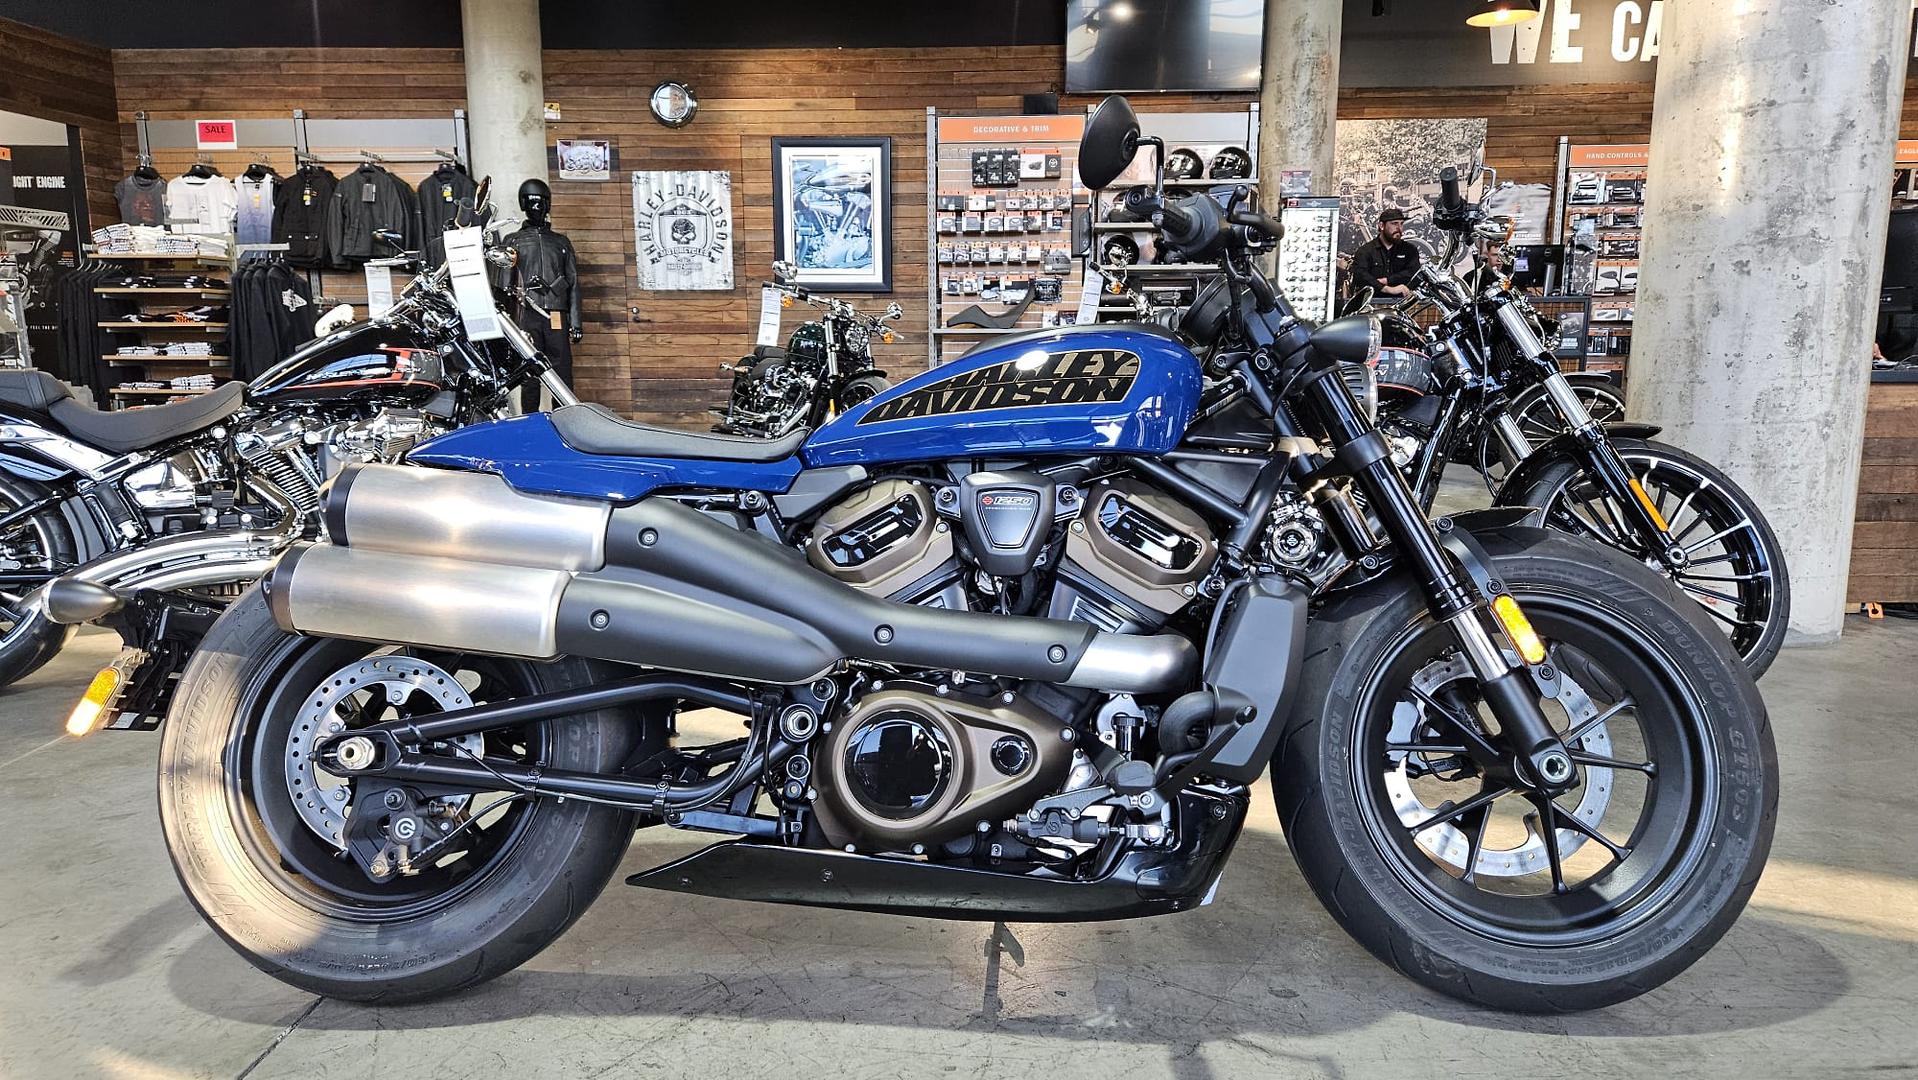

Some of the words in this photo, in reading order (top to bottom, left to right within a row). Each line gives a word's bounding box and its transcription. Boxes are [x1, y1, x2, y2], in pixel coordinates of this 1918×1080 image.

[1488, 0, 1583, 64] WE
[205, 125, 226, 133] SALE
[36, 175, 66, 188] ENGINE
[638, 184, 728, 256] HARLEY-DAVIDSON
[856, 376, 1134, 425] DAVIDSON
[994, 496, 1033, 505] 1250
[1656, 619, 1737, 720] DUNLOP
